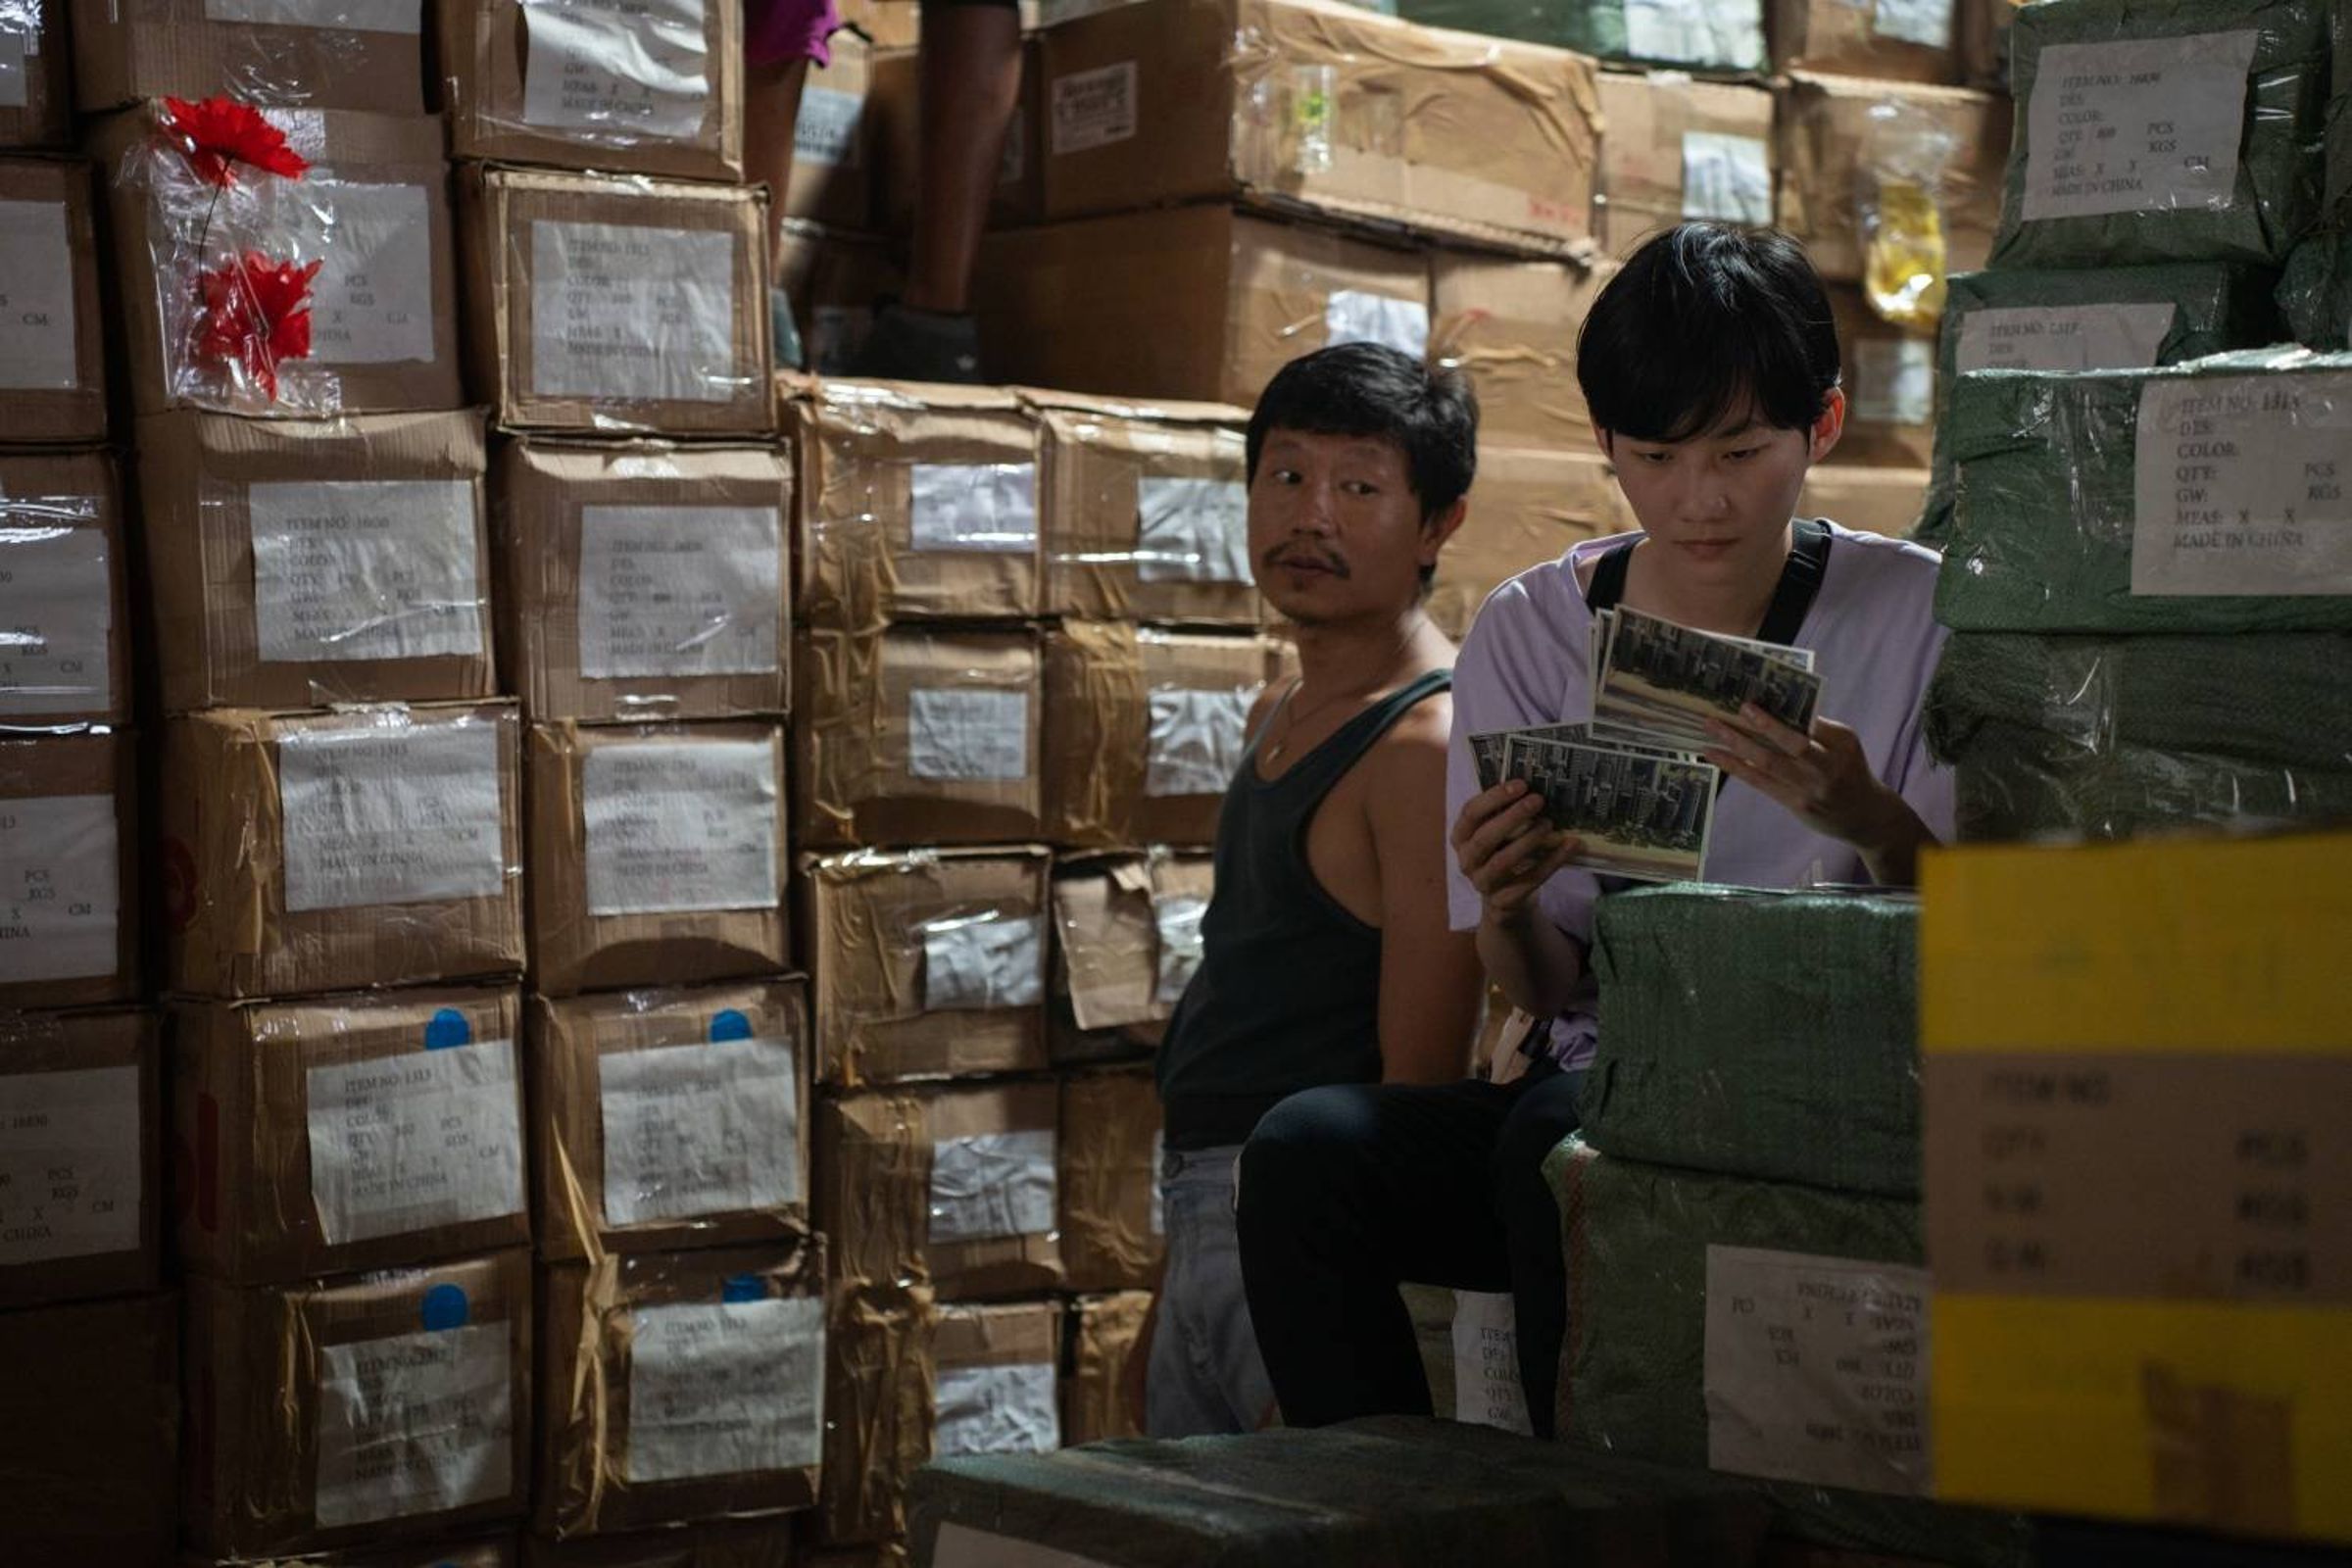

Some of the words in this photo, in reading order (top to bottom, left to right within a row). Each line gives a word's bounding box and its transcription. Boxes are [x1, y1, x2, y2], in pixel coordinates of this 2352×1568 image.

[2146, 122, 2175, 135] PCS
[2147, 139, 2178, 154] KGS
[2183, 155, 2210, 170] CM
[2101, 177, 2144, 194] CHINA
[22, 314, 49, 326] CM
[2182, 396, 2222, 414] ITEM
[2177, 441, 2239, 460] COLOR:
[2175, 465, 2218, 483] QTY:
[2304, 463, 2335, 478] PCS
[2175, 488, 2208, 503] GW:
[2307, 485, 2342, 501] KGS
[286, 516, 320, 531] ITEM
[2177, 510, 2223, 526] MEAS:
[2238, 510, 2249, 524] X
[2283, 507, 2296, 524] X
[2173, 530, 2222, 549] MADE
[2225, 531, 2245, 549] IN
[2247, 529, 2304, 547] CHINA
[24, 869, 50, 883] PCS
[27, 886, 56, 903] KGS
[68, 903, 92, 916] CM
[345, 1076, 377, 1094] ITEM
[33, 1206, 44, 1221] X
[91, 1200, 115, 1214] CM
[3, 1225, 53, 1243] CHINA
[1732, 1296, 1756, 1314] CM
